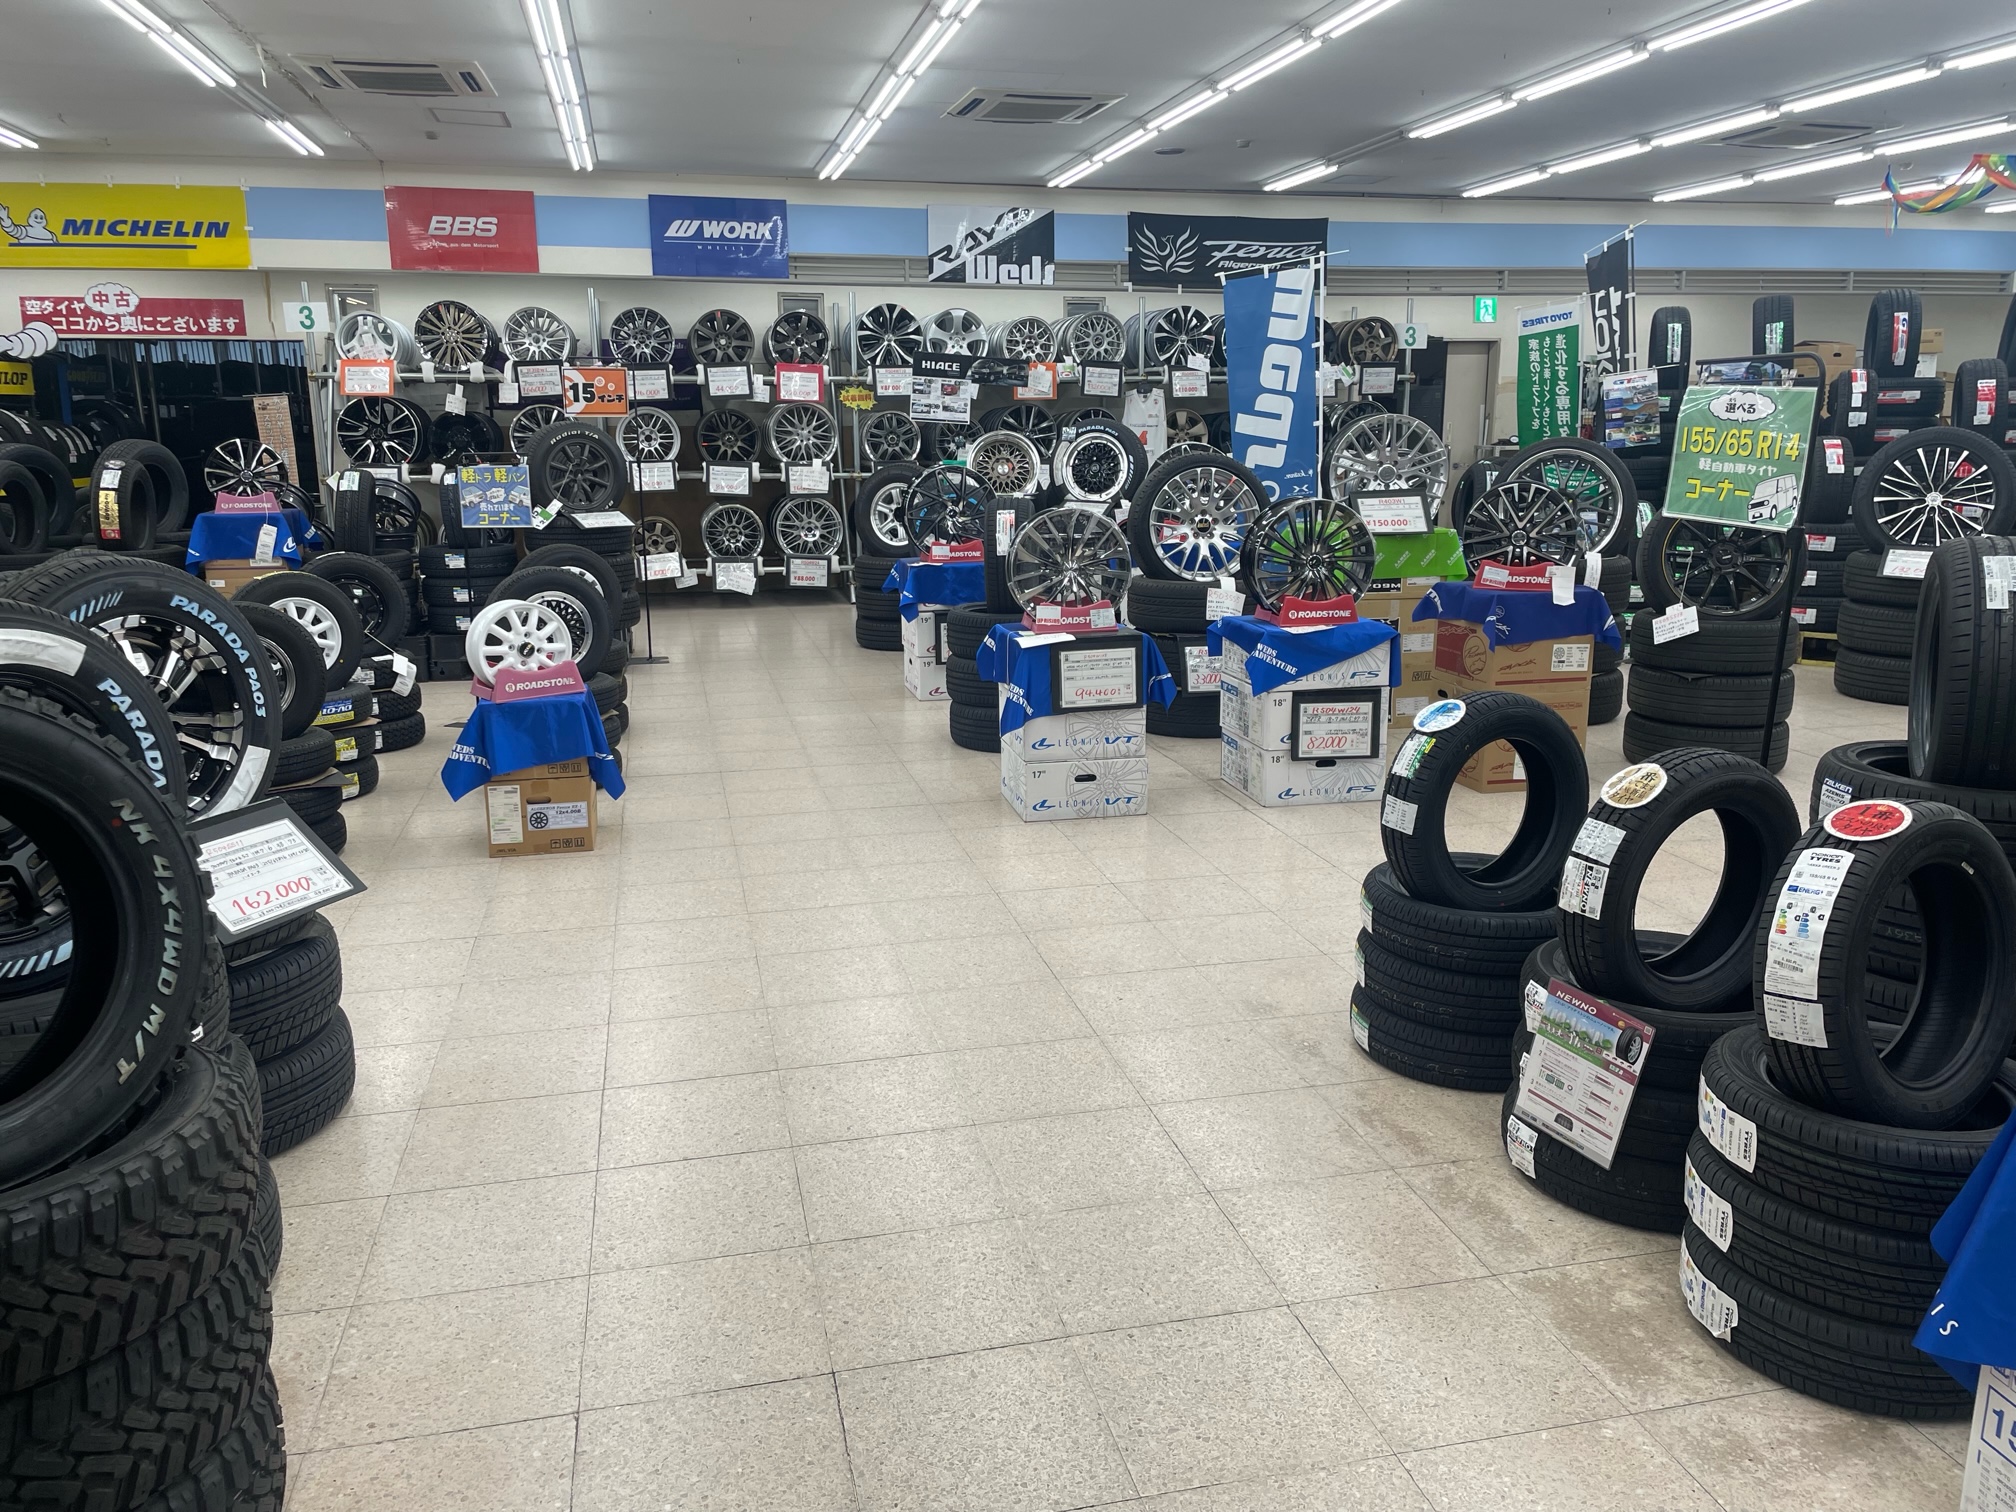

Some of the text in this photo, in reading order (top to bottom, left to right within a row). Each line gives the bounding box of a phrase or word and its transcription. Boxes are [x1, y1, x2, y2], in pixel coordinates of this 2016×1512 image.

[61, 219, 230, 238] MICHELIN
[427, 216, 498, 237] BBS
[703, 220, 772, 240] WORK
[92, 291, 130, 308] 中古
[25, 300, 85, 315] 空タイヤ
[52, 315, 239, 332] ココから奥にございます
[300, 306, 314, 329] 3
[1404, 326, 1417, 347] 3
[922, 360, 960, 371] HIACE
[569, 382, 596, 403] 15
[598, 394, 624, 403] インチ
[1725, 402, 1756, 414] 選べる
[1681, 426, 1801, 461] 155/65 R14
[1698, 458, 1777, 477] 軽自動車タイヤ
[461, 468, 525, 483] 軽トラ 軽バン
[1685, 478, 1750, 502] コーナー
[479, 512, 521, 525] コーナー
[1508, 576, 1551, 584] ADSTONE
[1298, 610, 1352, 618] ROADSTONE
[170, 595, 267, 718] PARADA PA03
[1257, 642, 1278, 657] WEDS
[1251, 650, 1298, 676] ADVENTURE
[1306, 670, 1381, 682] LEONIS FS
[516, 677, 575, 691] ROADSTONE
[1273, 699, 1286, 707] 18"
[96, 678, 167, 788] PARADA
[1058, 735, 1139, 747] LEONIS VT
[1271, 755, 1284, 763] 18"
[1032, 770, 1046, 778] 17"
[1303, 785, 1377, 797] LEONIS FS
[1824, 778, 1852, 793] FALKEN
[1058, 796, 1139, 808] LEONIS VT
[1843, 824, 1872, 835] タイヤ
[110, 798, 183, 1085] NK 4X4WD M/T
[1555, 990, 1597, 1015] NEWNO
